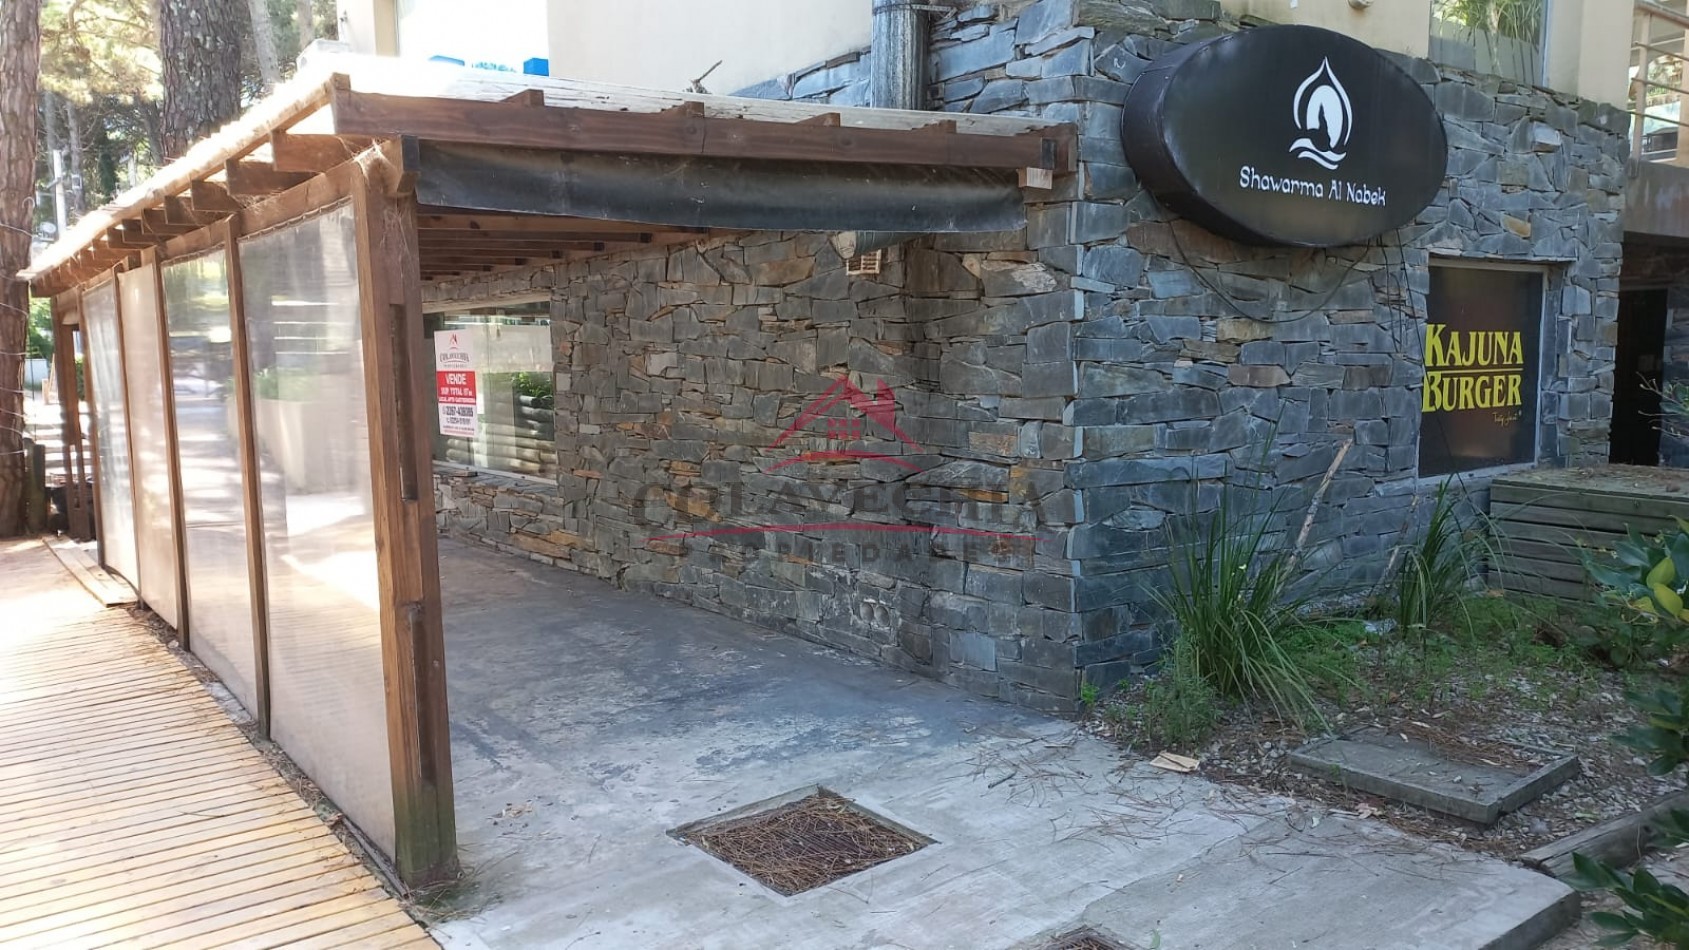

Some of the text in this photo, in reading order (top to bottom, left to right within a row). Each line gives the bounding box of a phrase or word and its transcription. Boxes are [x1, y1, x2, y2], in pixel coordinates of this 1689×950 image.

[1239, 165, 1387, 207] Shawarma Al Nabek
[1424, 323, 1524, 367] KAJUNA
[445, 373, 467, 385] VENDE
[1421, 371, 1522, 413] BURGER
